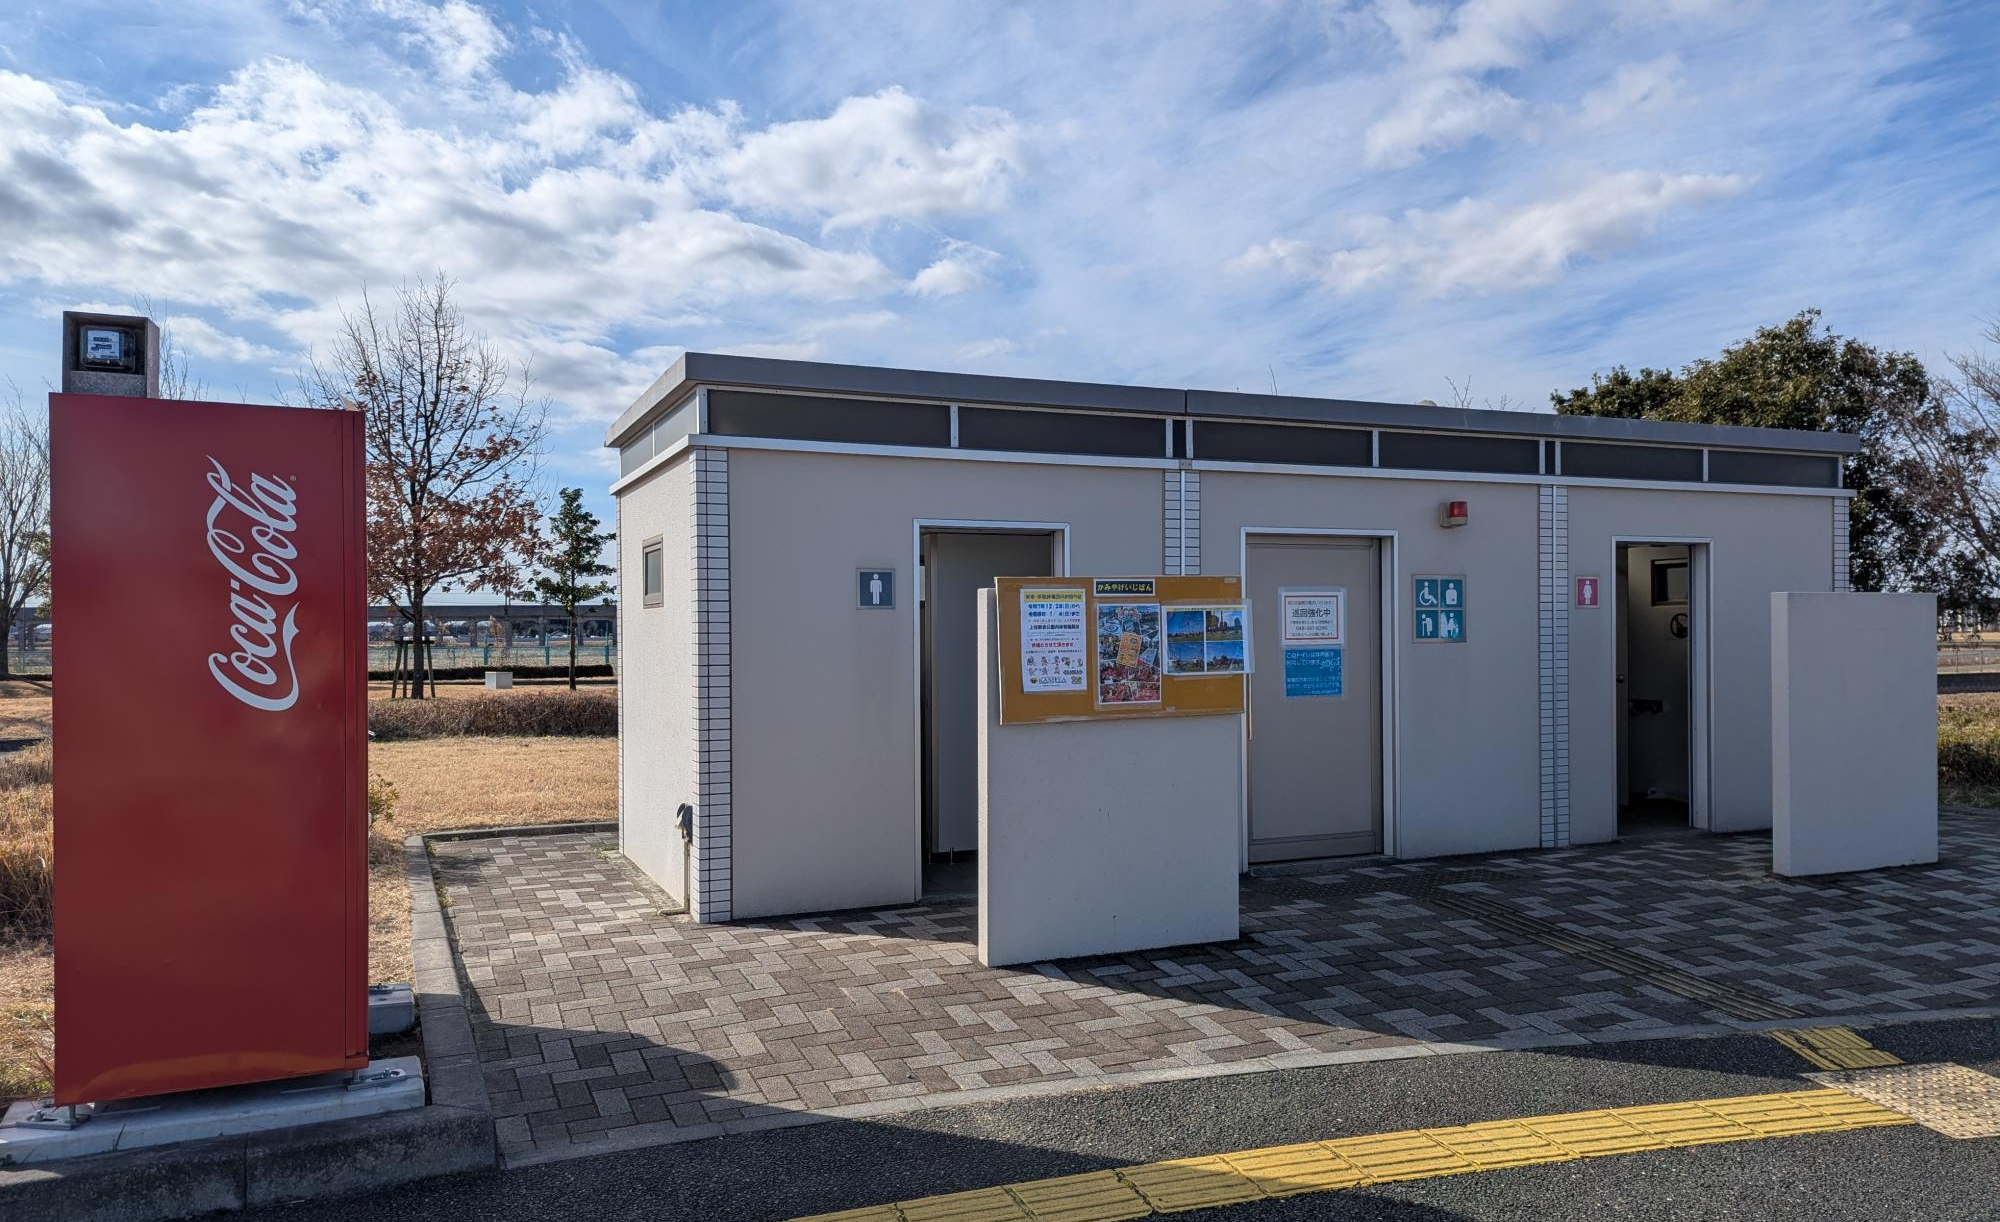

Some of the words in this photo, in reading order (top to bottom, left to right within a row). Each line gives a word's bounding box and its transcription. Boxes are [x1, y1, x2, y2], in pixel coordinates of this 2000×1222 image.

[206, 454, 299, 711] Coca-Cola
[1097, 583, 1153, 592] かみやけいじばん
[1292, 608, 1331, 618] 巡回強化中
